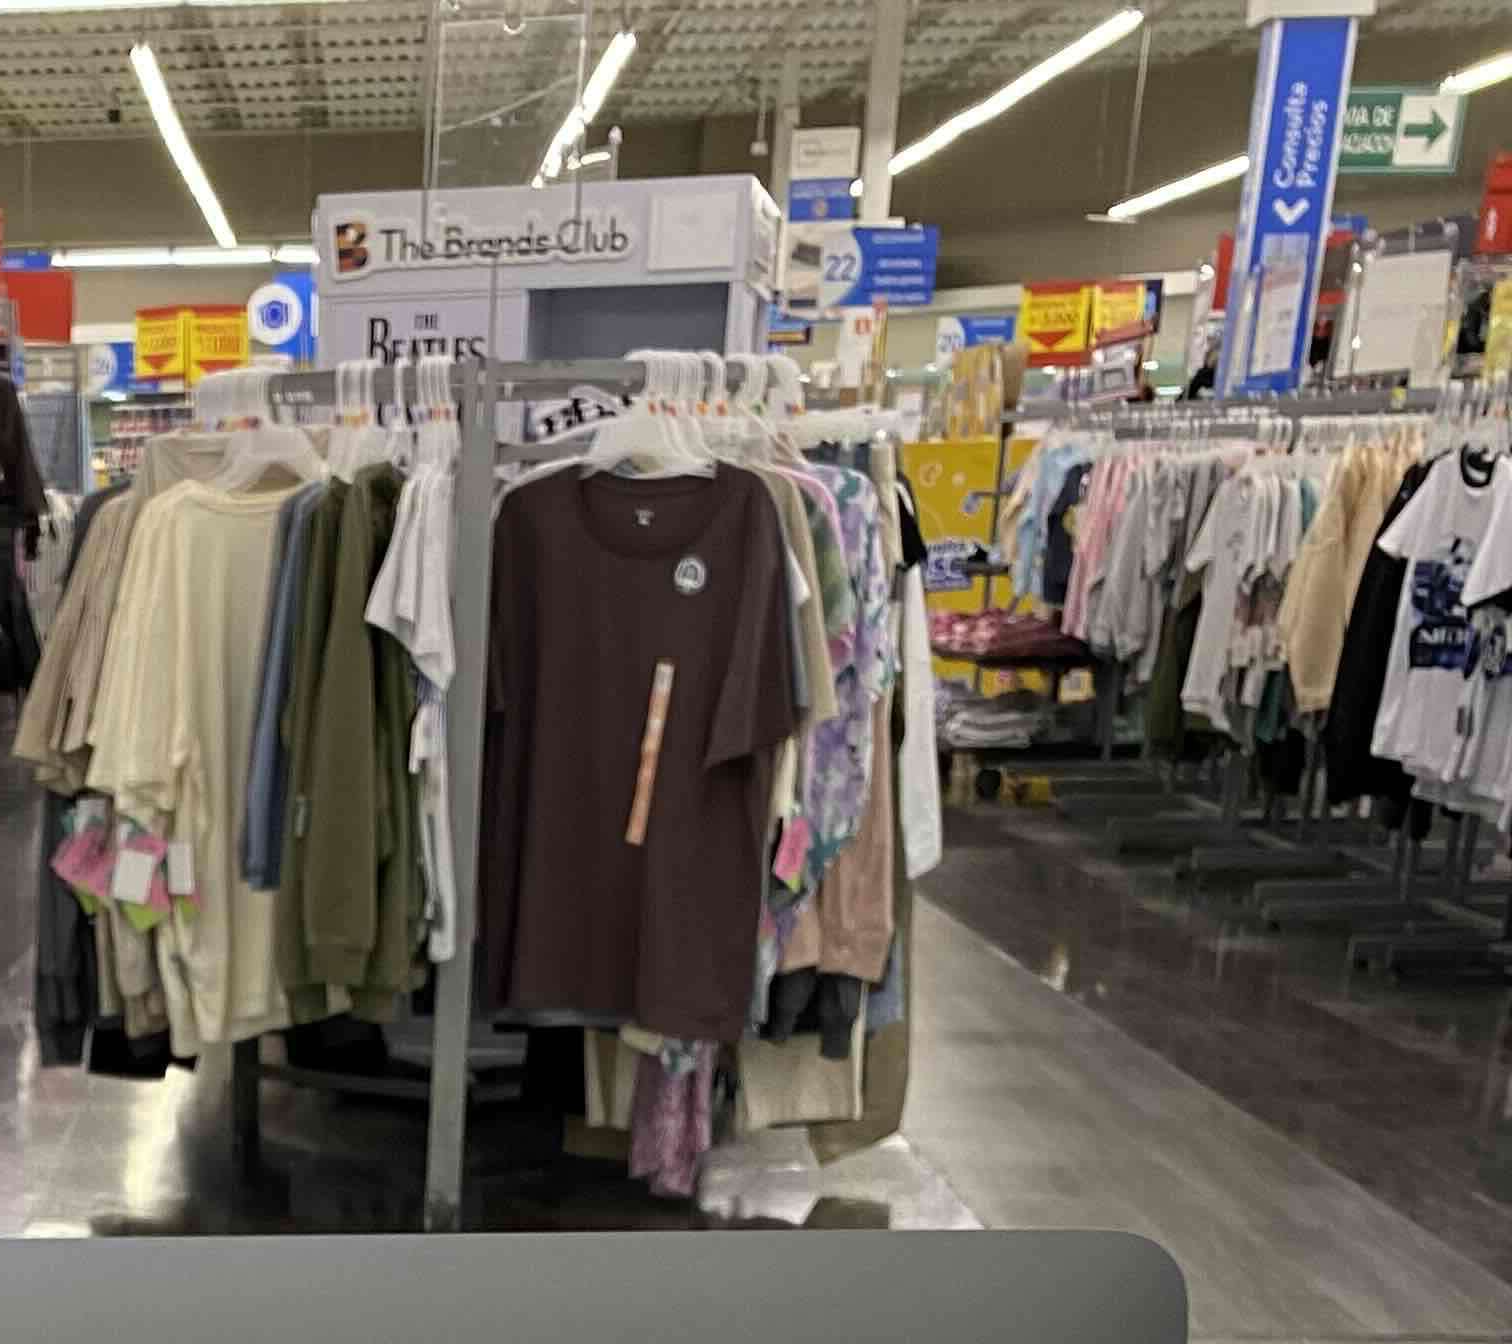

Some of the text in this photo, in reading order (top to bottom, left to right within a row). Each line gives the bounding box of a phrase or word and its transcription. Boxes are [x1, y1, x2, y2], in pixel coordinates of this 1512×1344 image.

[1273, 81, 1308, 188] Consulta
[1295, 100, 1328, 187] Precios
[379, 217, 629, 261] The Brands Club
[823, 255, 858, 282] 22
